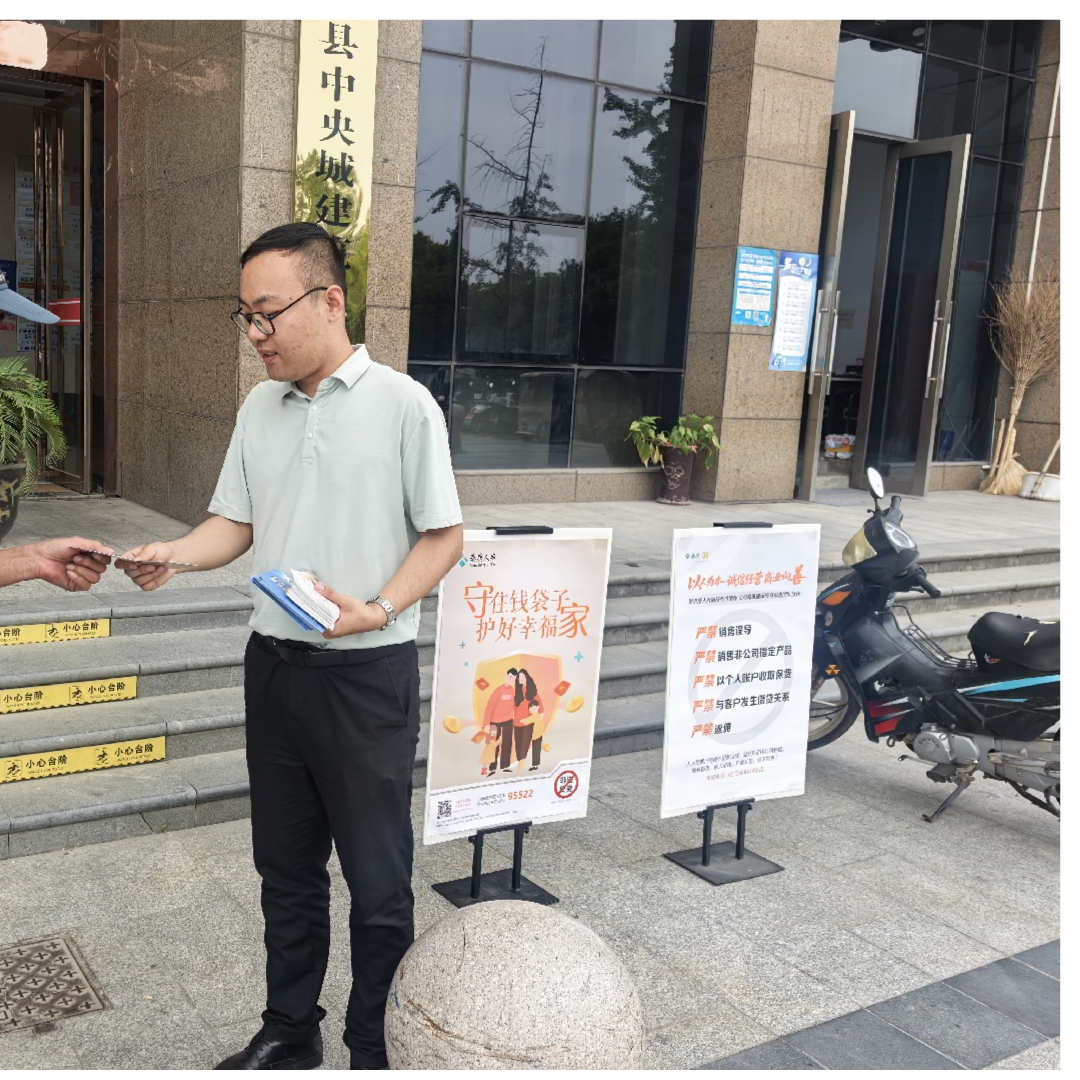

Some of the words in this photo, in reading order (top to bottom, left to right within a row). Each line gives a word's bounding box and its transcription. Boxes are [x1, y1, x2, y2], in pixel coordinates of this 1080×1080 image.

[315, 21, 359, 262] 县中央城建
[464, 581, 570, 619] 守住钱袋子
[63, 621, 99, 632] 小心台阶
[476, 602, 590, 643] 护好幸福家
[695, 625, 718, 640] 严禁
[719, 624, 752, 638] 销售误导
[694, 649, 716, 664] 严禁
[717, 645, 792, 662] 销售非公司指定产品
[692, 674, 715, 689] 严禁
[716, 668, 792, 686] 以个人账户收取保费
[3, 690, 44, 703] 小心台阶
[87, 682, 126, 695] 小心台阶
[692, 698, 715, 714] 严禁
[716, 692, 790, 710] 与客户发生借贷关系
[690, 722, 714, 738] 严禁
[114, 743, 155, 757] 小心台阶
[25, 754, 68, 769] 小心台阶
[507, 789, 534, 800] 95522
